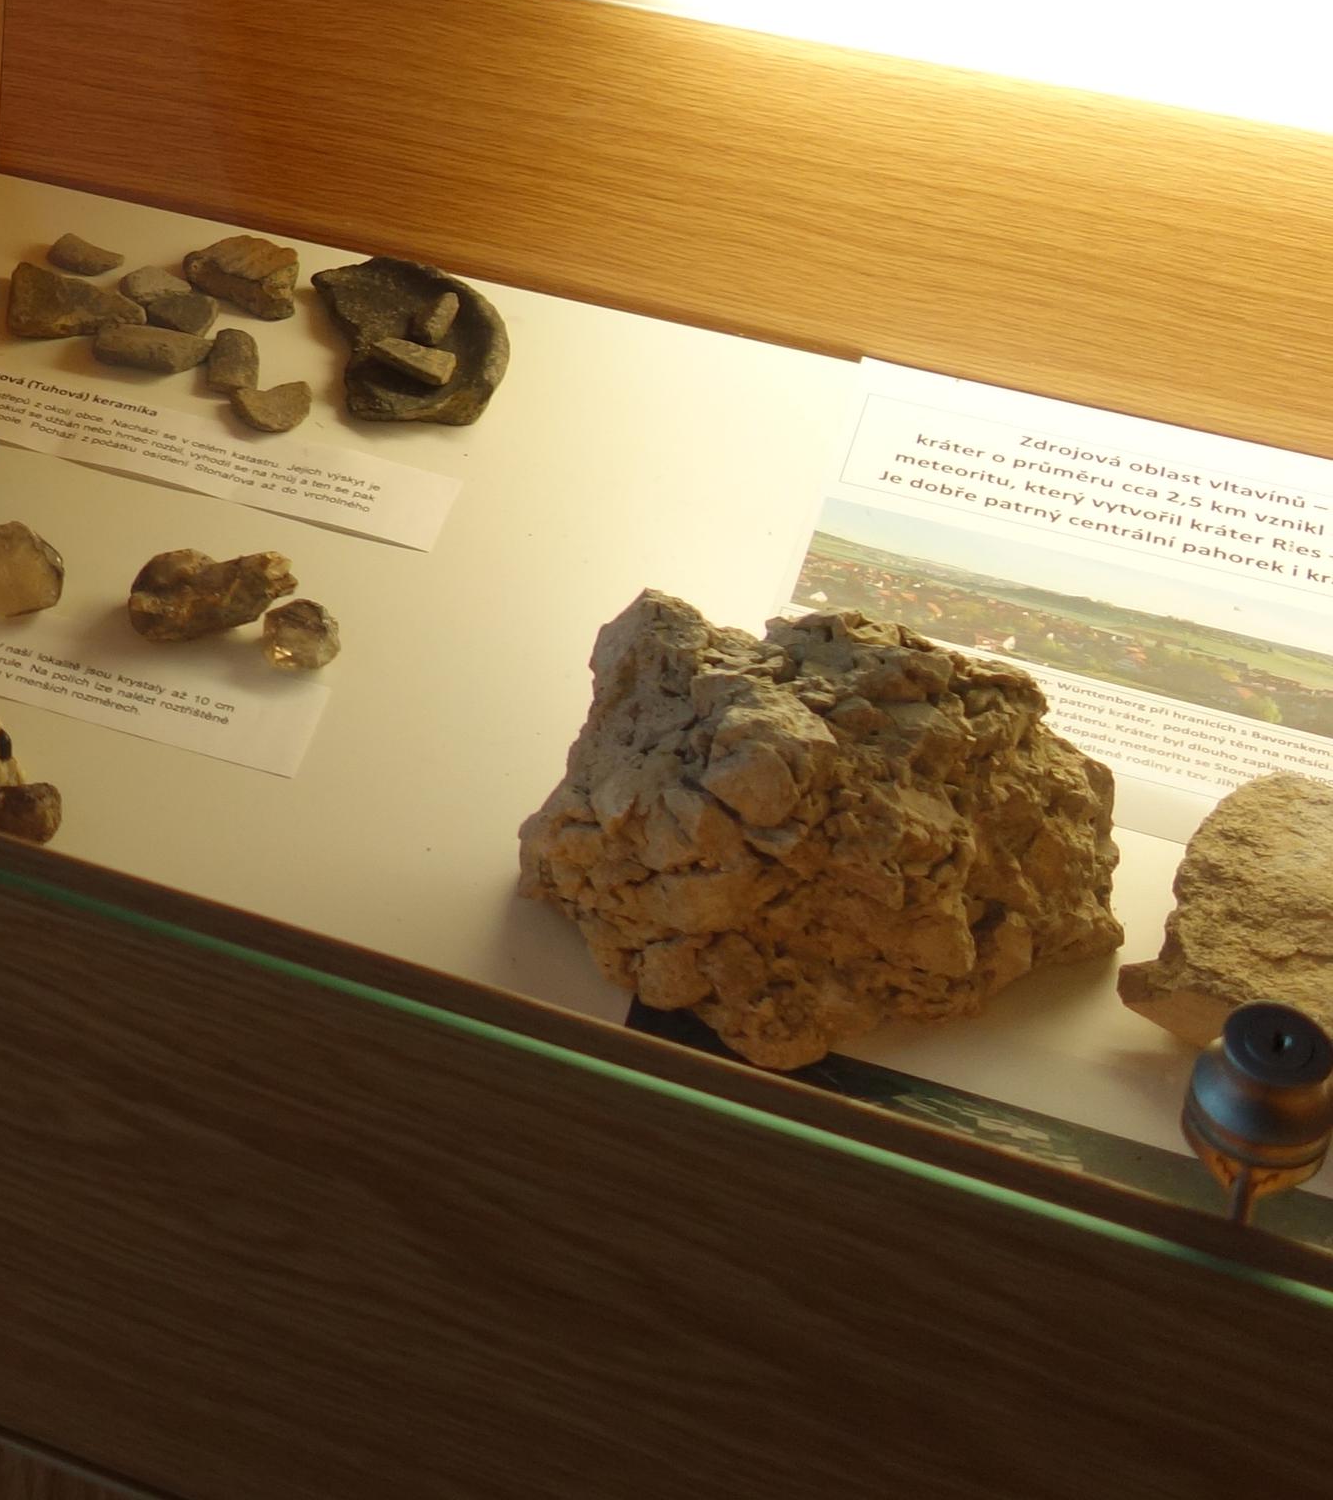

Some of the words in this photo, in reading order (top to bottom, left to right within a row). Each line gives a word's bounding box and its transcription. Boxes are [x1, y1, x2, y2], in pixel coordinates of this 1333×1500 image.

[26, 380, 91, 402] (Tuhová)
[92, 393, 159, 418] keramika
[894, 452, 1016, 490] meteoritu,
[1024, 480, 1086, 506] který
[1091, 497, 1183, 527] vytvořil
[1190, 518, 1265, 546] kráter
[916, 433, 987, 459] kráter
[991, 452, 1006, 463] o
[1012, 457, 1114, 488] průměru
[1121, 482, 1160, 499] cca
[1166, 490, 1203, 508] 2,5
[1210, 500, 1247, 518] km
[1254, 512, 1325, 537] vznikl
[1019, 435, 1121, 468] Zdrojová
[1128, 461, 1203, 487] oblast
[1209, 479, 1306, 509] vltavínů
[878, 470, 903, 485] Je
[909, 477, 978, 502] dobře
[983, 496, 1062, 524] patrný
[1068, 514, 1177, 548] centrální
[1181, 542, 1285, 574] pahorek
[1291, 565, 1299, 577] i
[36, 652, 82, 672] lokalitě
[82, 665, 113, 681] jsou
[116, 674, 167, 695] krystaly
[170, 689, 188, 701] až
[193, 694, 211, 707] 10
[214, 701, 236, 713] cm
